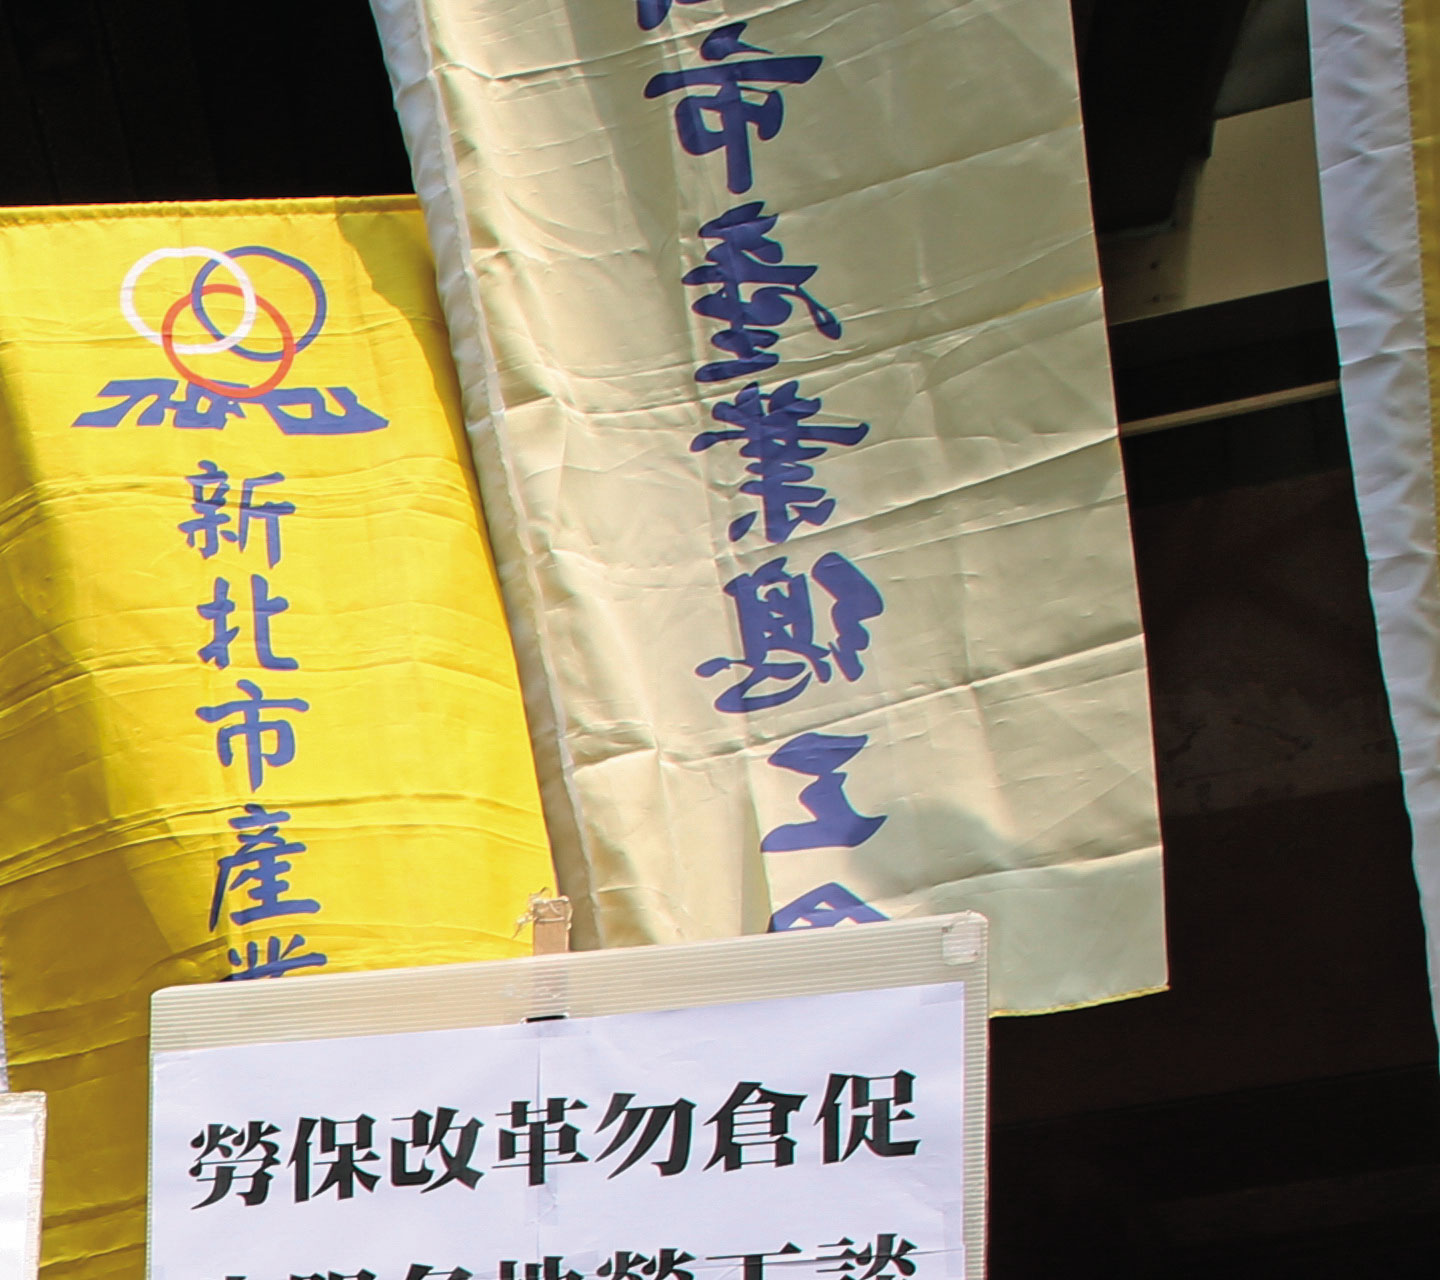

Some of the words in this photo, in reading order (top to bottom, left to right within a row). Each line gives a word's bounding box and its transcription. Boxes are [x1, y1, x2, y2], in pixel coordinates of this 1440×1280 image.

[188, 1070, 922, 1210] 勞保改革勿倉促
